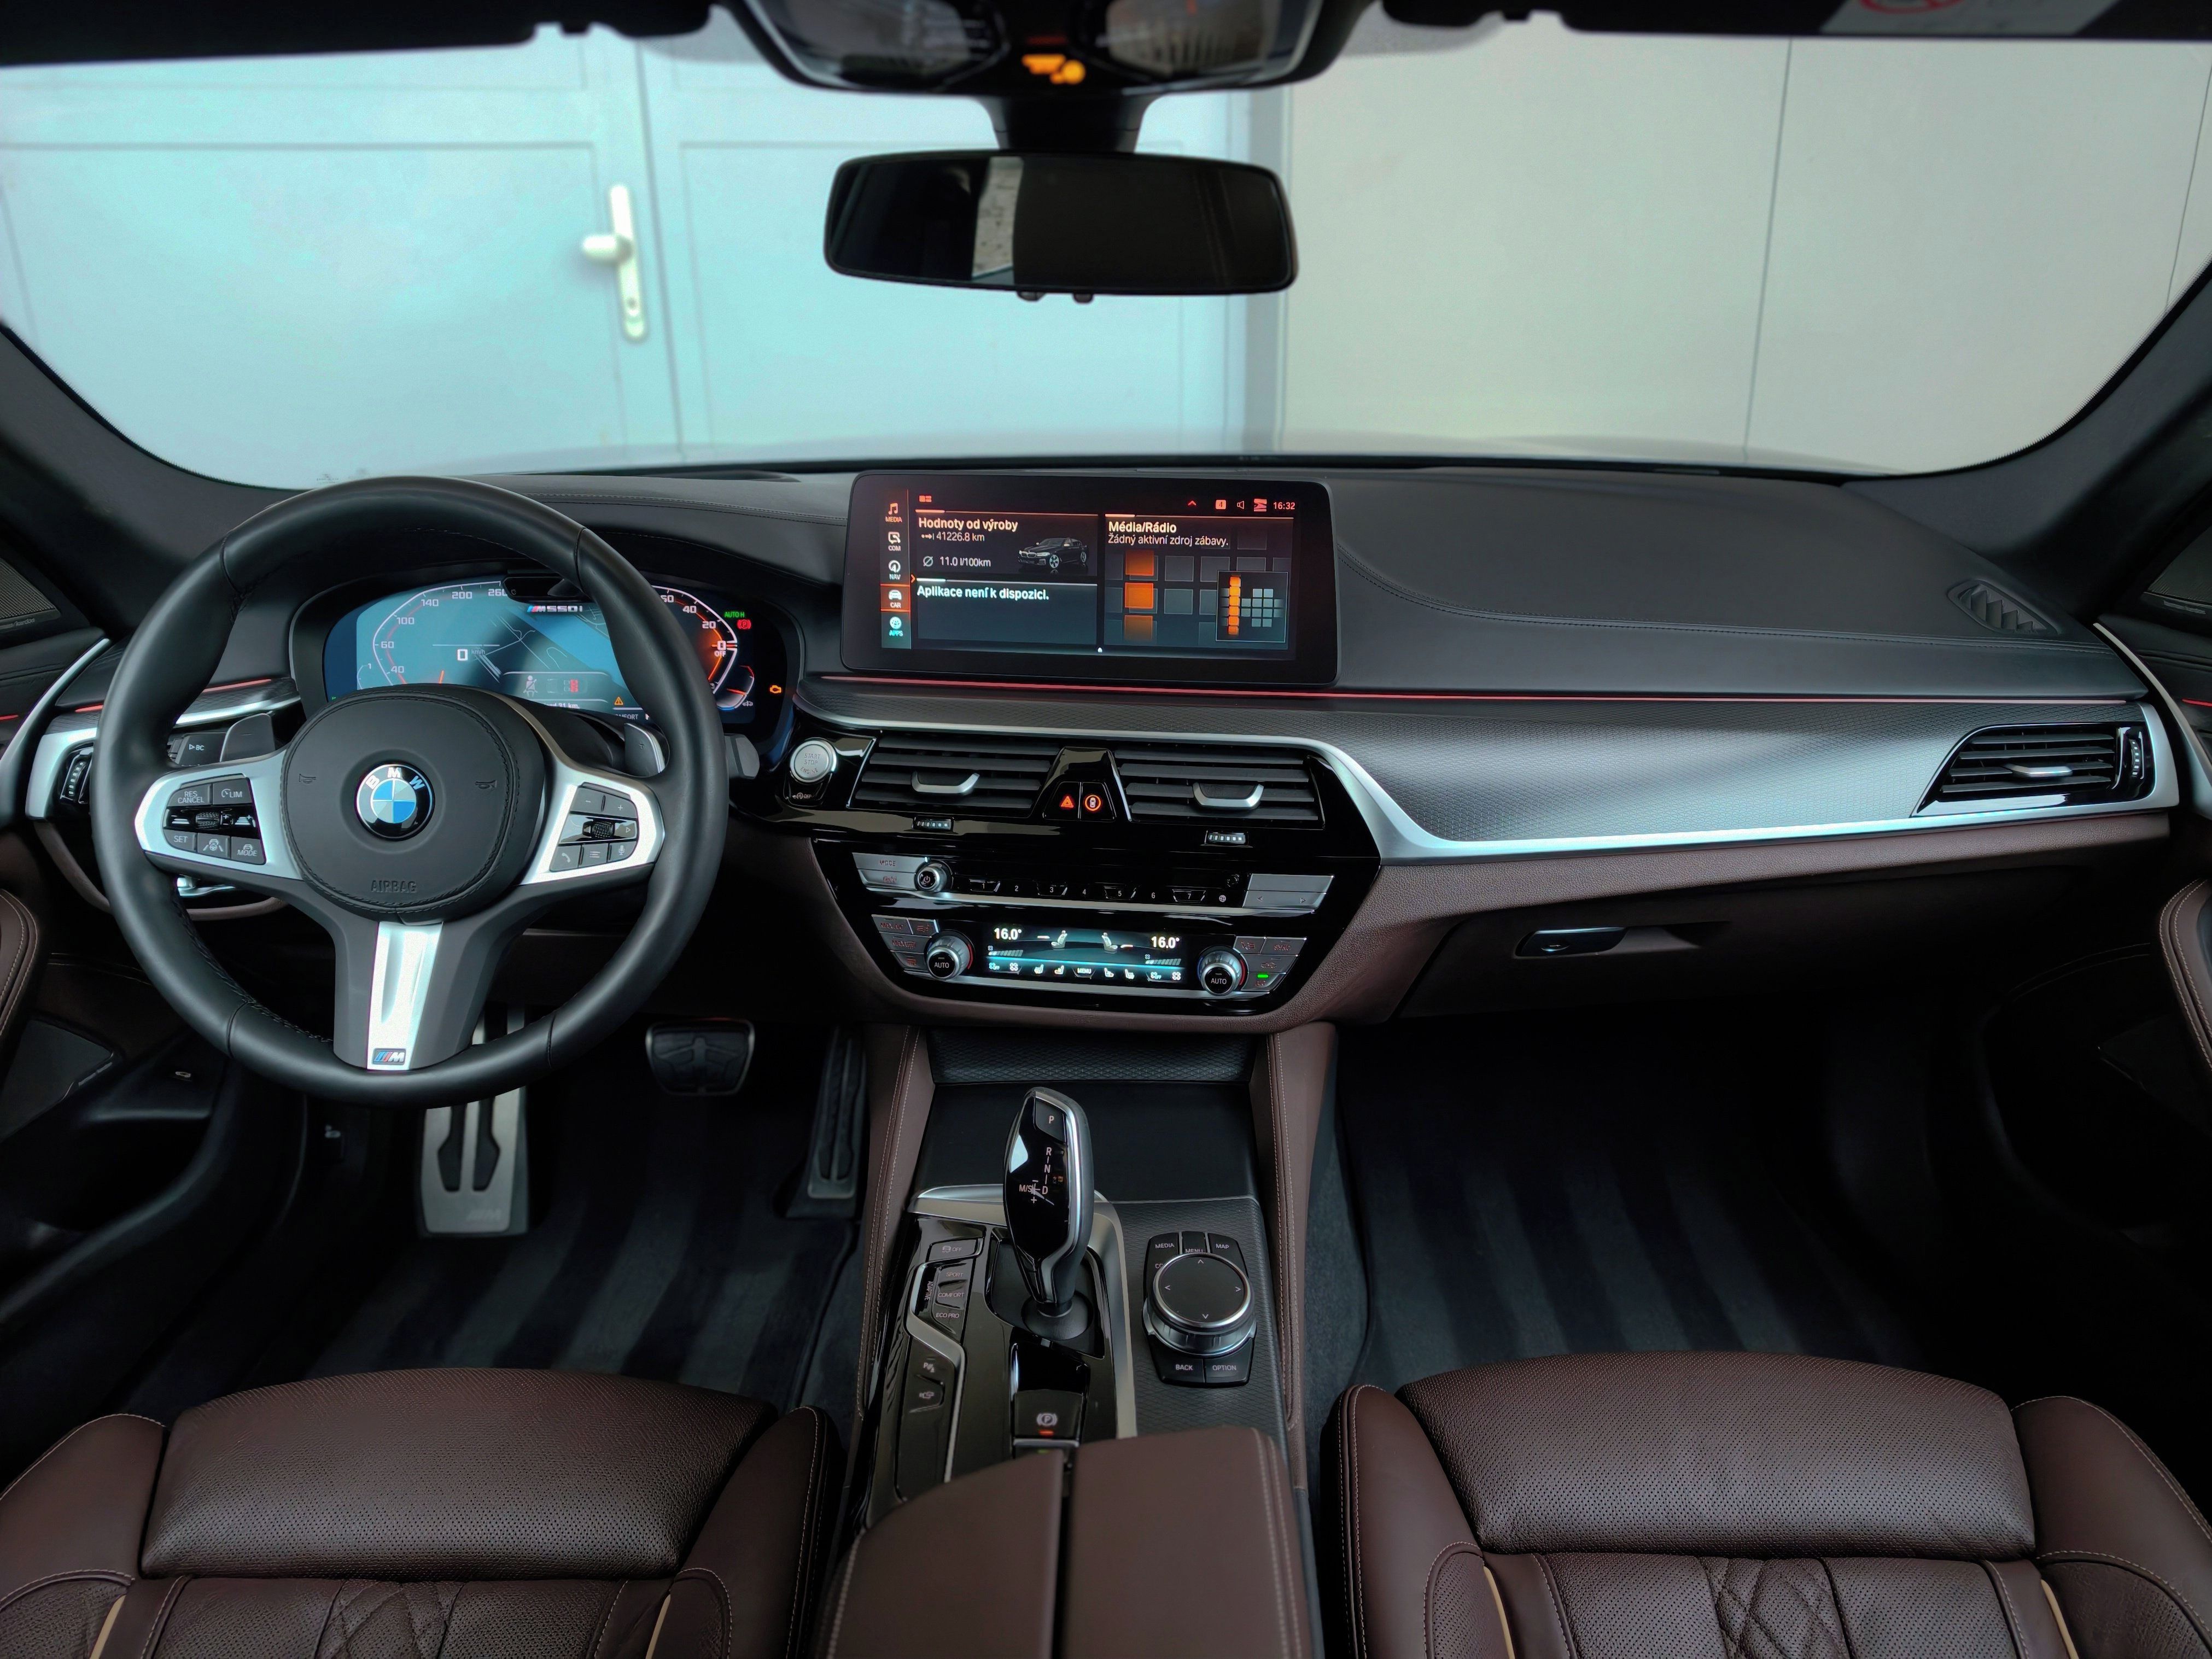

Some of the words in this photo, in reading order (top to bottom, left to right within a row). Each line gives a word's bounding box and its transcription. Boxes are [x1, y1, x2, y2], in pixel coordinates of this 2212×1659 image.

[919, 517, 964, 530] Hodnoty
[966, 519, 980, 529] od
[983, 518, 1018, 532] výroby
[1108, 521, 1177, 533] Média/Rádio
[936, 531, 970, 541] 41226.8
[972, 532, 985, 541] km
[1108, 532, 1136, 546] Žádný
[1138, 535, 1168, 545] aktivní
[1170, 535, 1193, 547] zdroj
[1195, 536, 1229, 547] zábavy.
[940, 556, 958, 566] 11.0
[451, 591, 472, 599] 200
[917, 585, 962, 598] Aplikace
[965, 587, 989, 598] není
[990, 587, 997, 598] k
[999, 588, 1049, 601] dispozici.
[421, 599, 439, 607] 140
[682, 605, 697, 614] 40
[396, 617, 415, 625] 100
[702, 621, 716, 629] 20
[381, 641, 394, 649] 60
[717, 640, 727, 651] 0
[458, 649, 468, 661] 0
[391, 665, 405, 674] 40
[365, 767, 425, 790] BMW
[370, 880, 418, 893] AIRBAG
[1048, 1115, 1054, 1124] P
[1046, 1147, 1052, 1156] R
[1044, 1164, 1051, 1173] N
[1042, 1186, 1048, 1195] D
